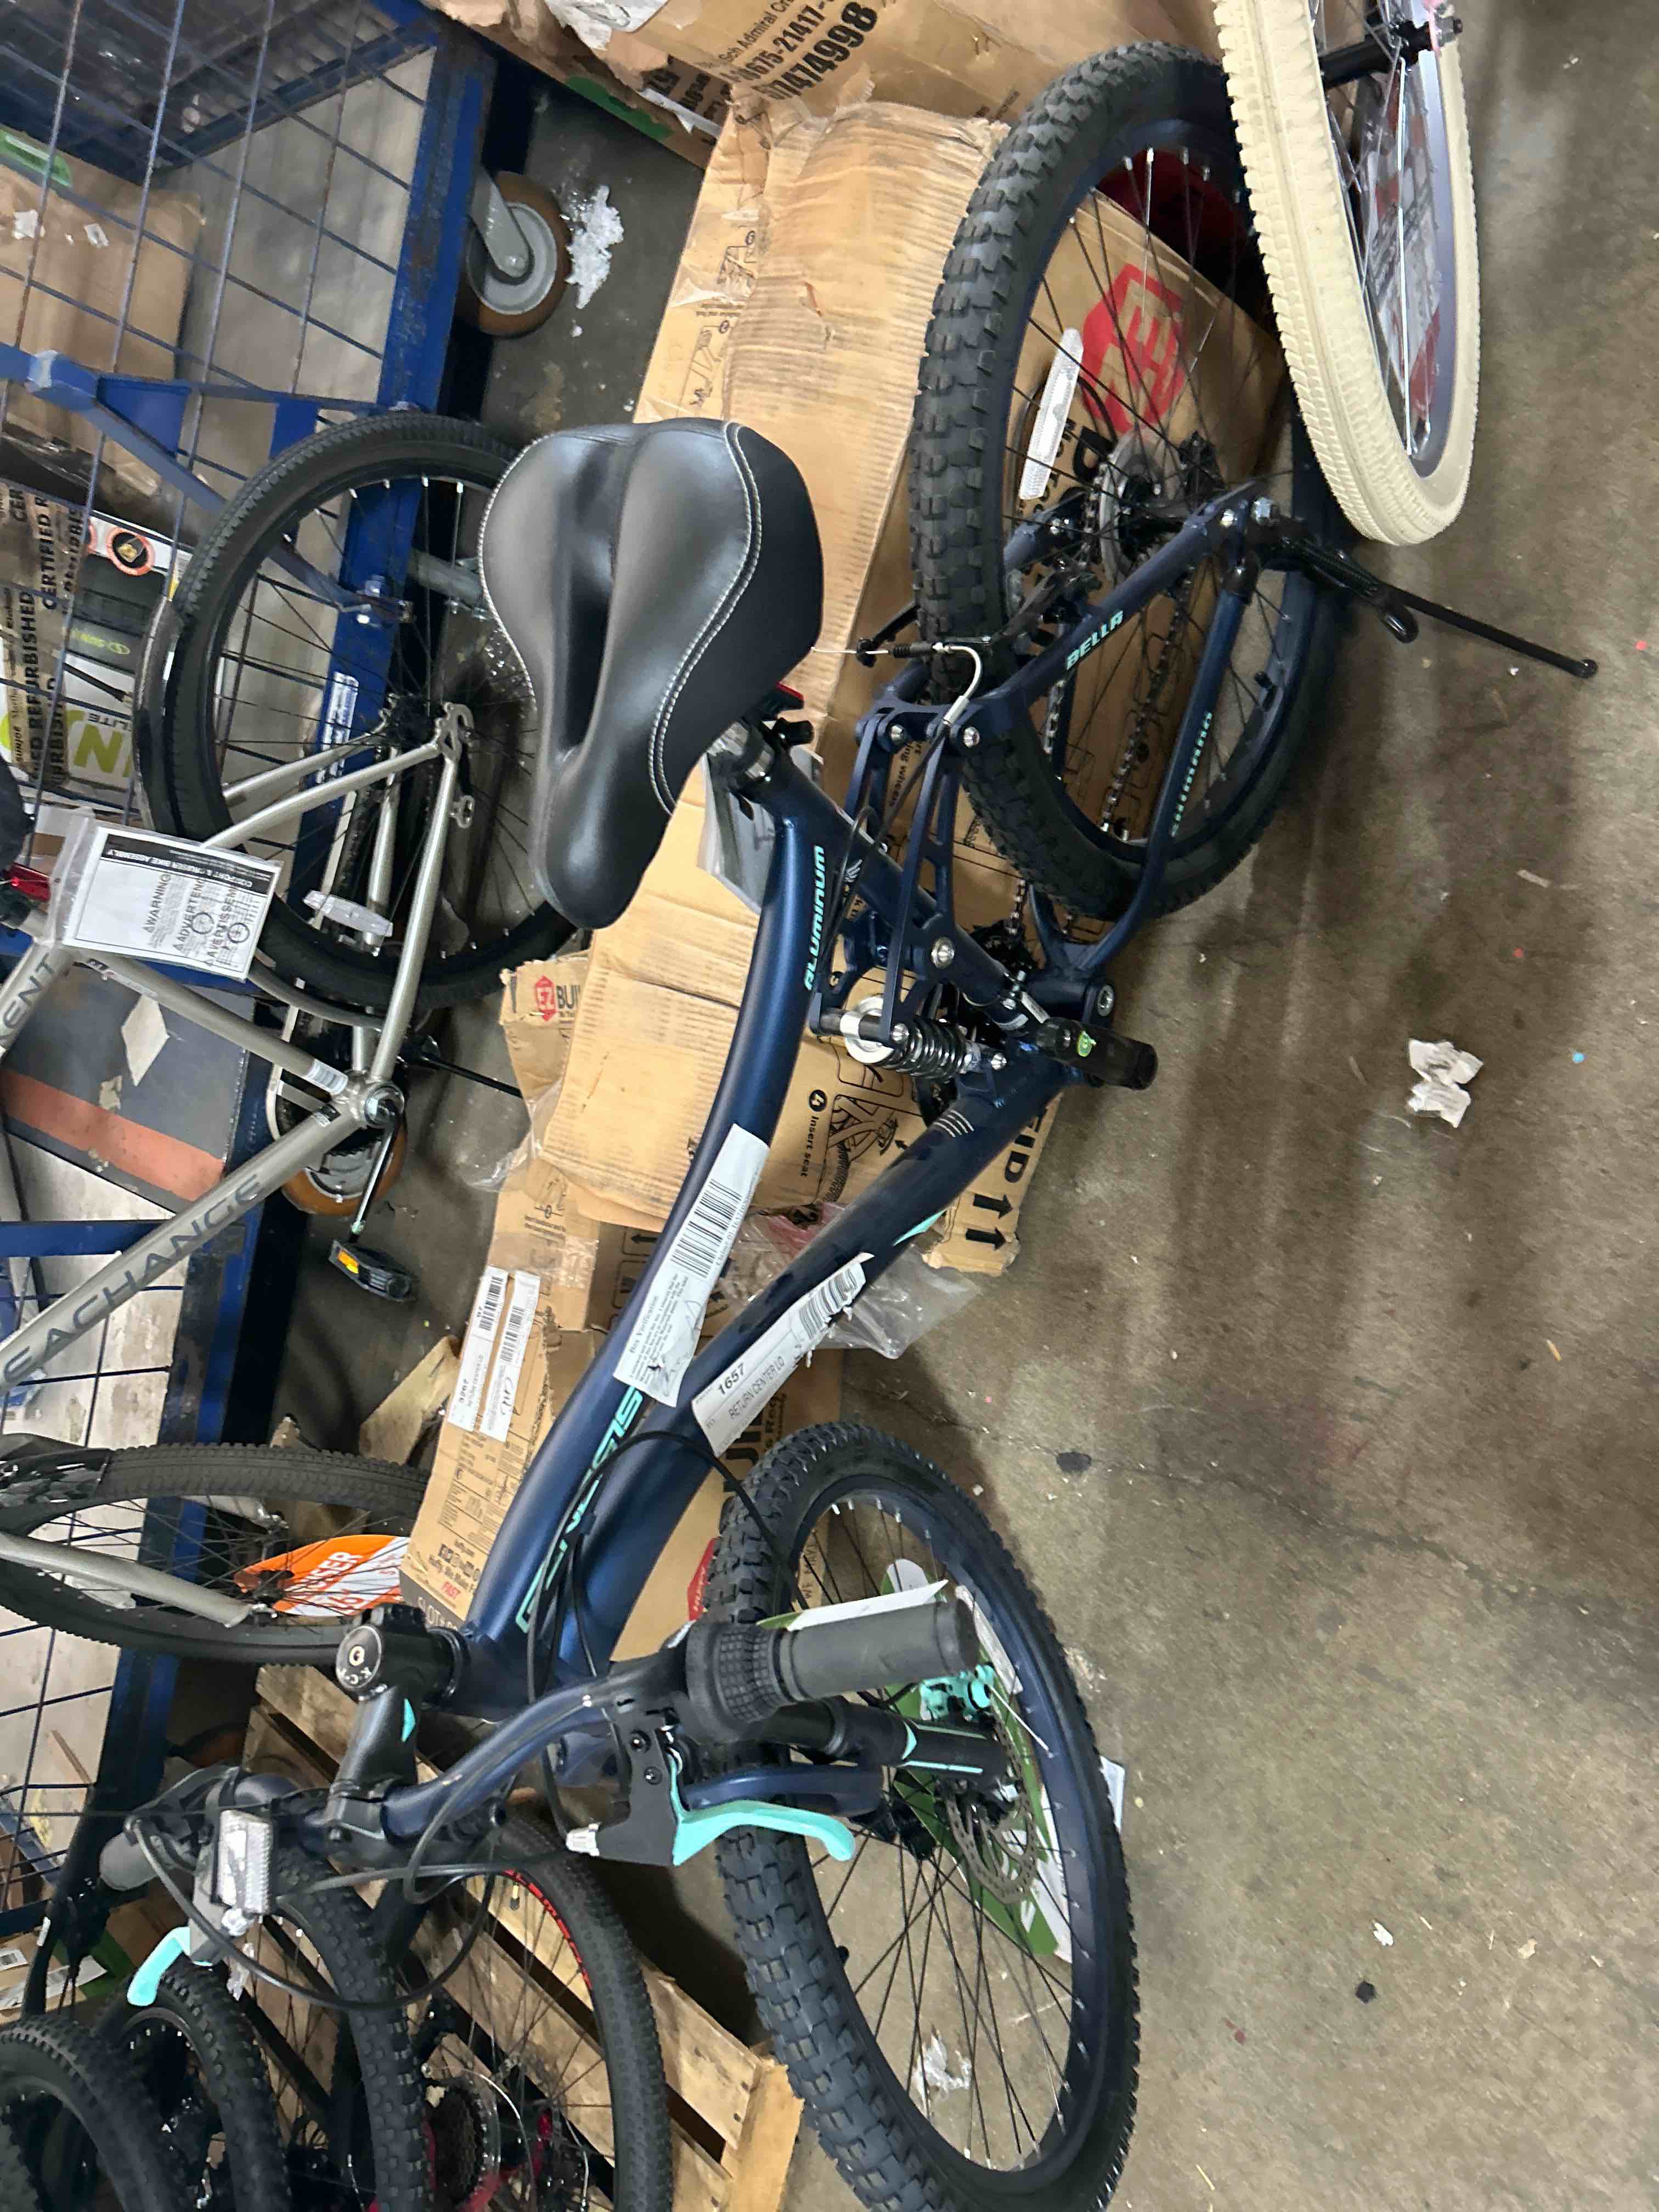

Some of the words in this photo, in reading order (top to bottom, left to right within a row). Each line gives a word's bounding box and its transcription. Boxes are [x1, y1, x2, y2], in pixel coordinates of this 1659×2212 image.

[738, 11, 777, 48] Admiral
[151, 857, 172, 867] BIKE
[146, 874, 171, 929] WARNING
[804, 844, 825, 991] ALUMINUM
[805, 1115, 819, 1151] Insert
[800, 1153, 810, 1177] seat
[636, 1296, 658, 1336] Verification
[718, 1362, 745, 1395] 1657
[729, 1388, 754, 1419] RETURN
[753, 1365, 776, 1395] CENTER
